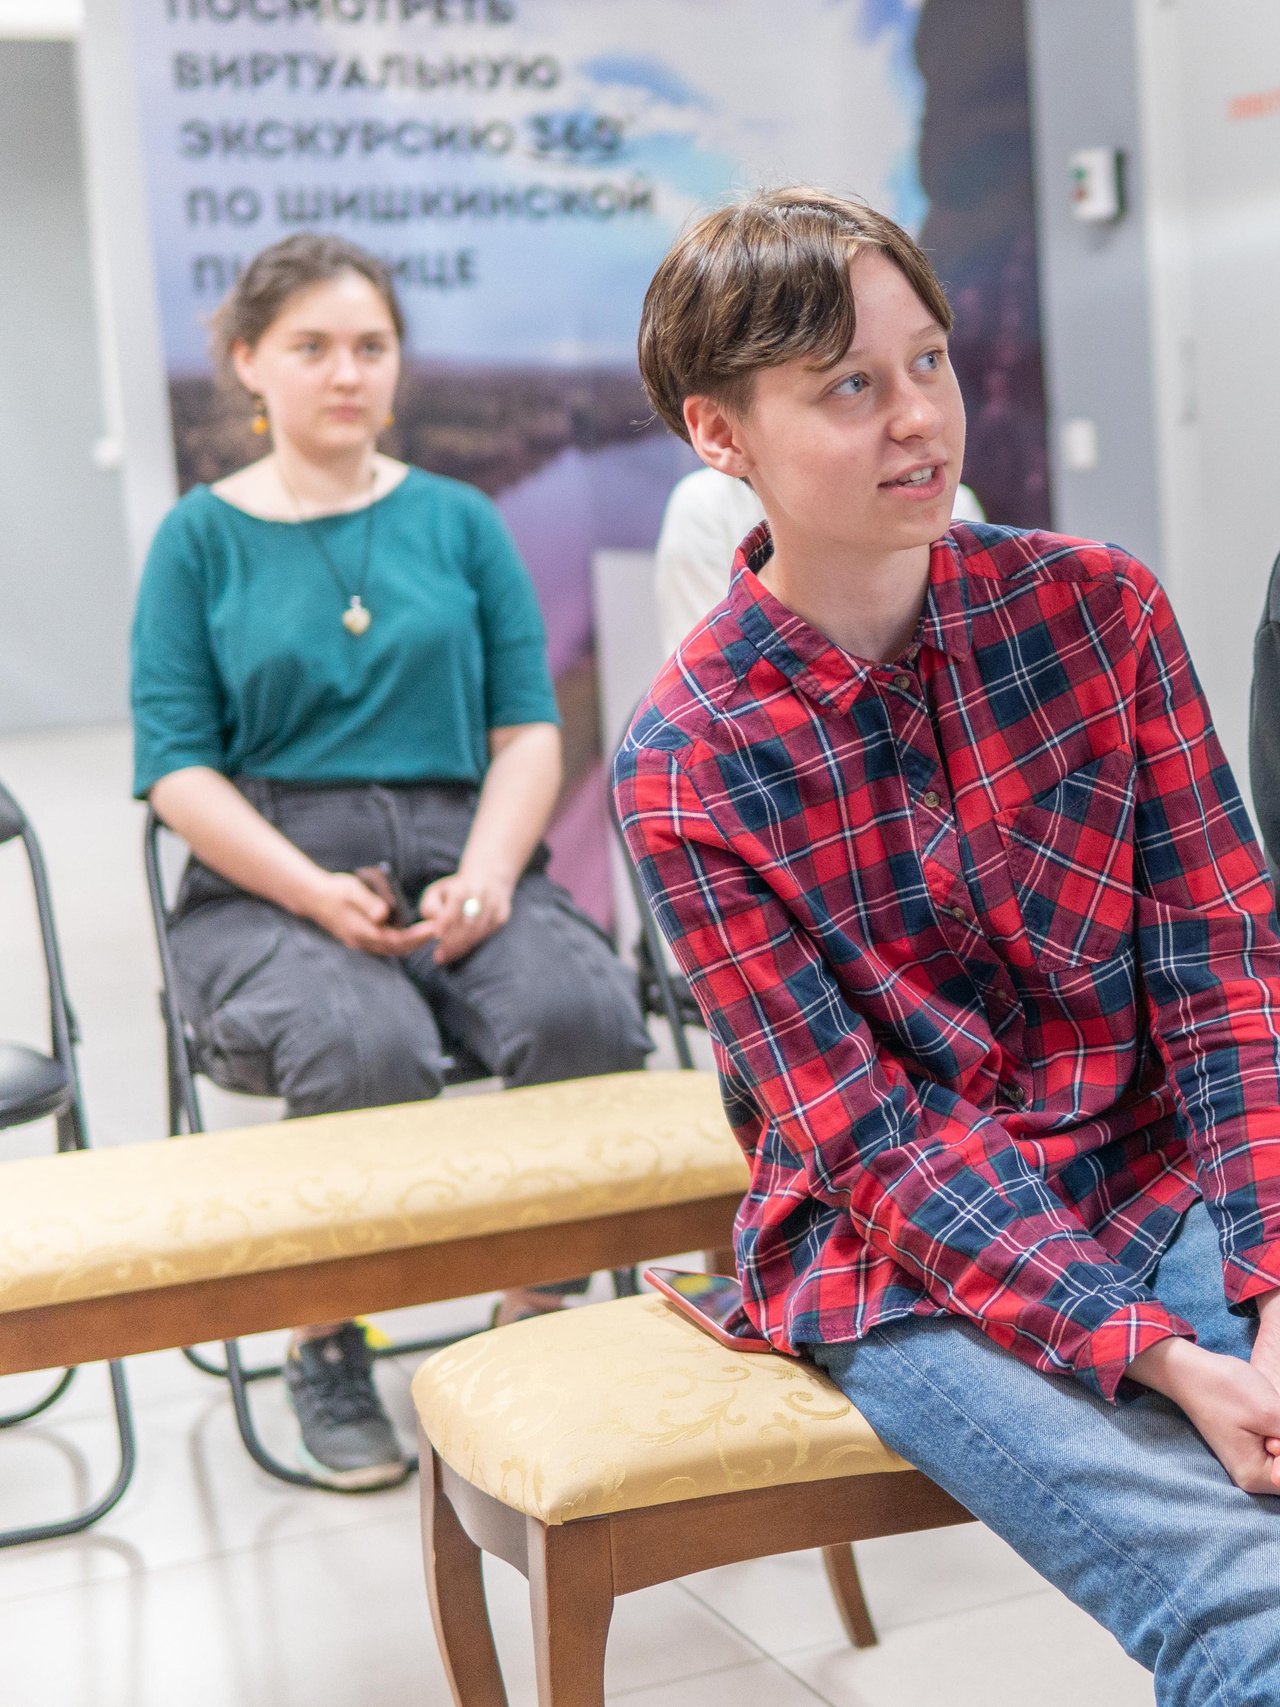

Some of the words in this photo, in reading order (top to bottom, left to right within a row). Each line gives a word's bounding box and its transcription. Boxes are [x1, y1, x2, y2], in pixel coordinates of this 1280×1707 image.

[174, 50, 562, 91] ВИРТУАЛЬНУЮ
[182, 118, 516, 159] ЭКСКУРСИЮ
[186, 187, 264, 225] ПО
[276, 170, 655, 224] ШИШКИНСКОЙ
